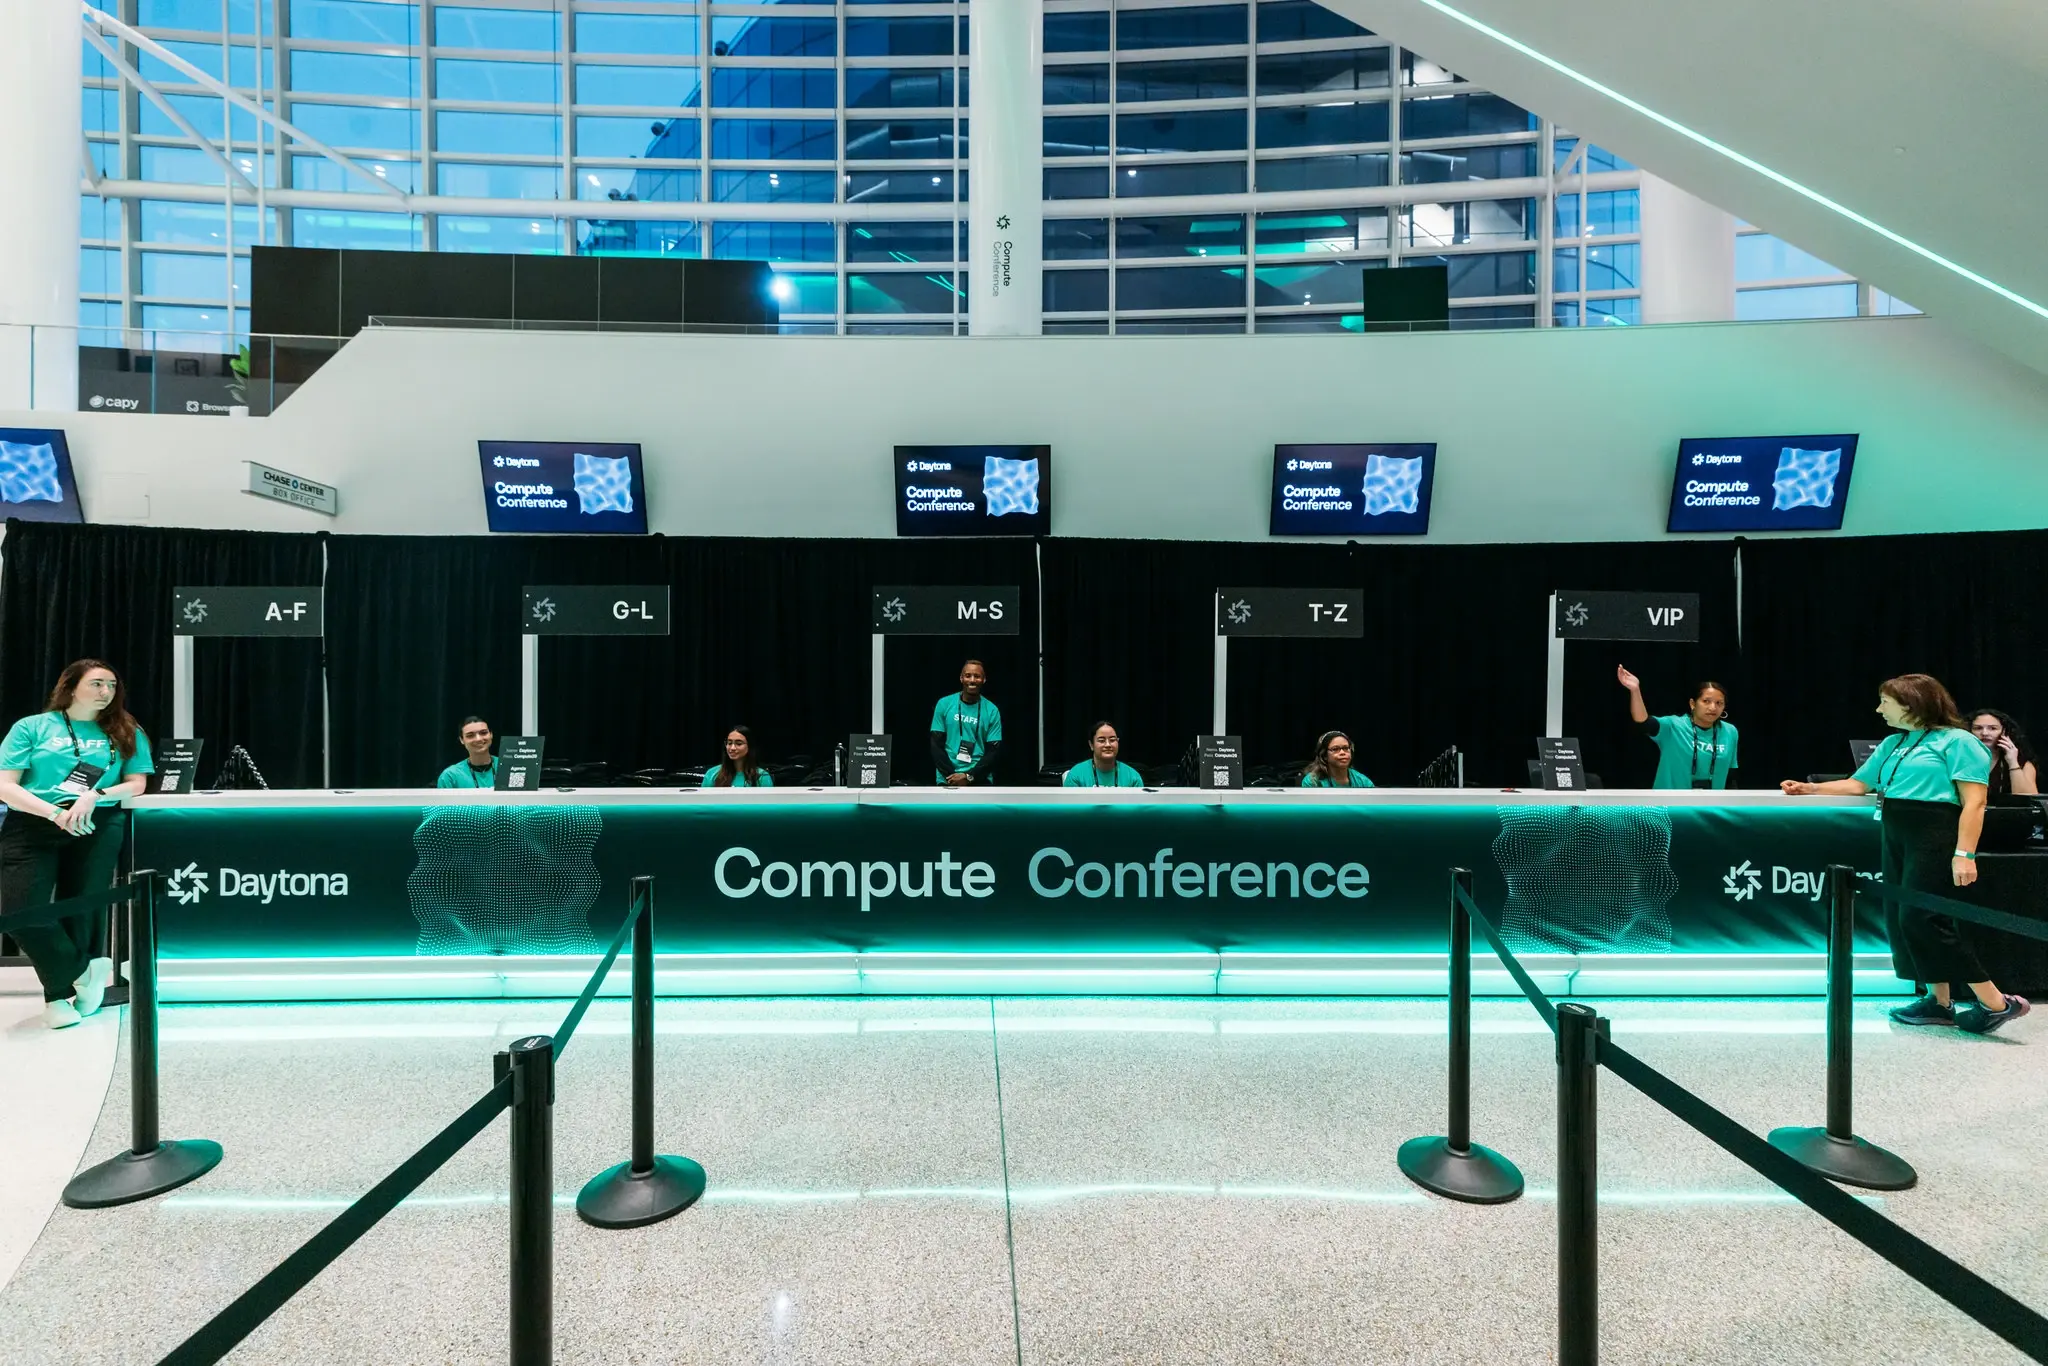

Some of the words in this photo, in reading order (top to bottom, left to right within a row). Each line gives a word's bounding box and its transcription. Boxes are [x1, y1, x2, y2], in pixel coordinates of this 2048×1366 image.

[993, 241, 1002, 298] Conference
[1002, 241, 1012, 287] Compute
[106, 398, 139, 410] capy
[506, 457, 540, 468] Daytona
[919, 461, 951, 472] Daytona
[1300, 460, 1332, 471] Daytona
[1706, 454, 1742, 466] Daytona
[264, 471, 290, 486] CHASE
[300, 482, 324, 496] CENTER
[494, 482, 553, 497] Compute
[1686, 480, 1749, 494] Compute
[273, 487, 288, 498] BOX
[290, 493, 316, 507] OFFICE
[906, 486, 962, 500] Compute
[1283, 484, 1341, 500] Compute
[496, 496, 568, 508] Conference
[907, 500, 975, 511] Conference
[1283, 498, 1352, 510] Conference
[1684, 494, 1760, 506] Conference
[264, 602, 307, 621] A-F
[612, 600, 654, 620] G-L
[958, 600, 1004, 620] M-S
[1308, 603, 1348, 622] T-Z
[1646, 608, 1684, 626] VIP
[51, 737, 106, 748] STAFF
[219, 868, 348, 904] Daytona
[714, 846, 996, 912] Compute
[1028, 846, 1370, 899] Conference
